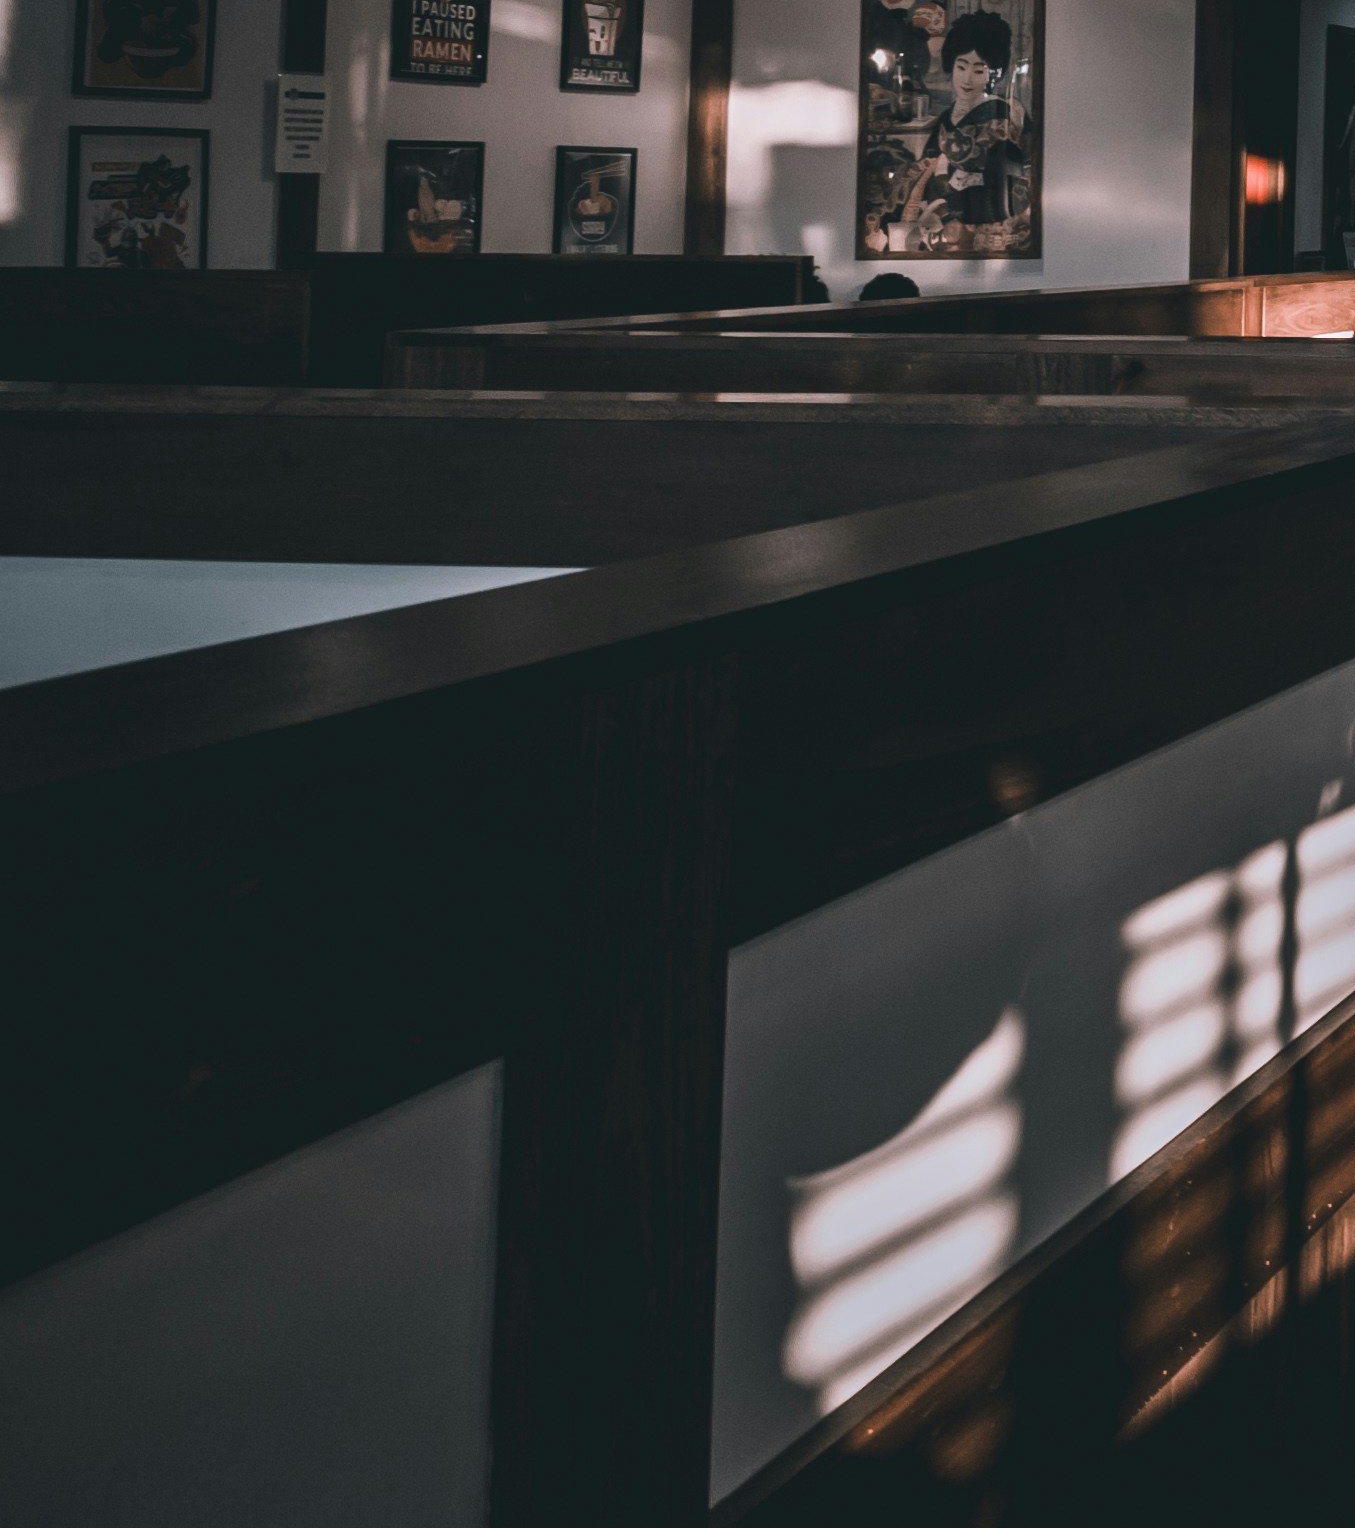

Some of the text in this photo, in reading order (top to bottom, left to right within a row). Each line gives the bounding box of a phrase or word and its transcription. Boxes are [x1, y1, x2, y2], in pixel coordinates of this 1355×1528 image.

[412, 0, 476, 20] I PAUSED
[412, 17, 475, 41] EATING
[412, 39, 472, 62] RAMEN
[572, 68, 630, 84] BEAUTIFUL
